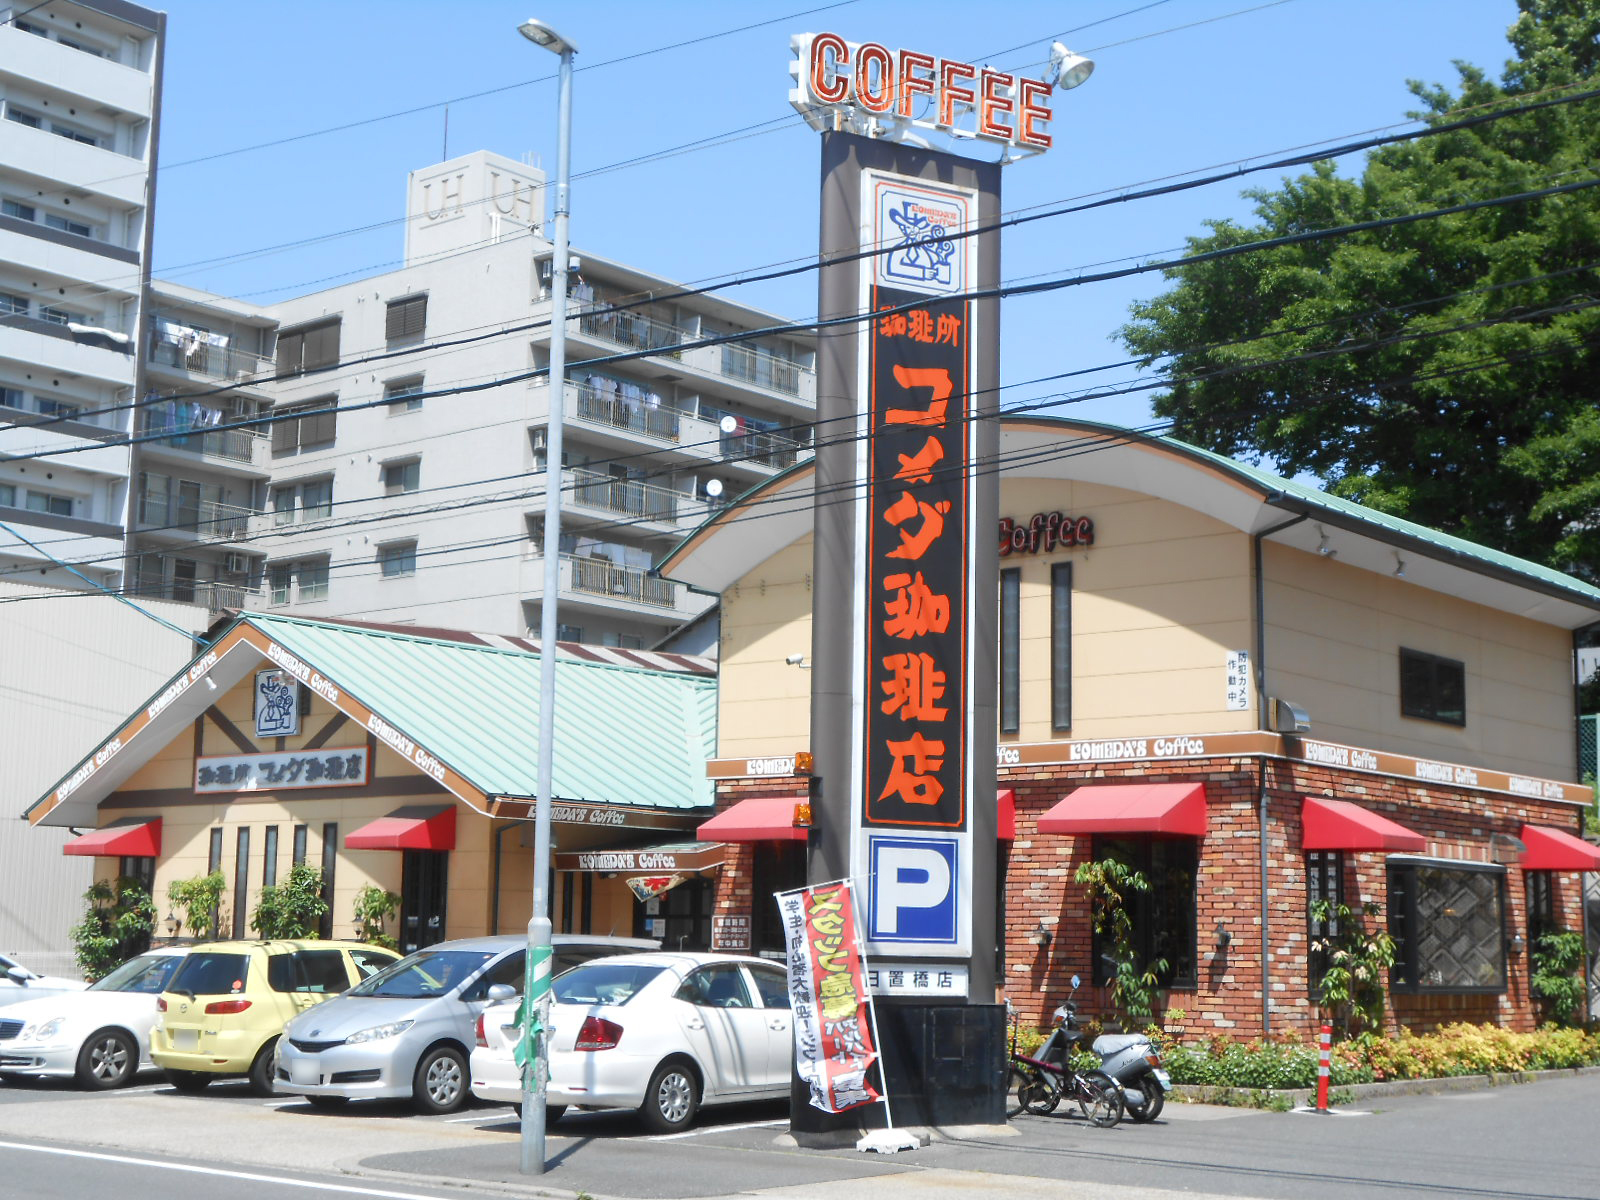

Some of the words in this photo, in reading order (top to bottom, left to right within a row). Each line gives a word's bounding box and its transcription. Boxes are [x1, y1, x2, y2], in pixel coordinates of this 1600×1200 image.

[810, 32, 1053, 148] COFFEE
[878, 364, 953, 806] コメダ珈琲店
[190, 651, 217, 680] Coffee
[311, 674, 339, 702] Coffee
[1227, 660, 1237, 702] 作動中
[1238, 652, 1248, 708] 防犯カメラ
[95, 738, 121, 766] Coffee
[1070, 740, 1147, 760] KOMEDA'S
[1153, 737, 1204, 756] Coffee
[1305, 743, 1349, 766] KOMEDA'S
[1351, 750, 1377, 770] Coffee
[415, 750, 446, 780] Coffee
[747, 759, 796, 775] KOMED
[1455, 767, 1478, 785] Coffee
[527, 805, 587, 822] KEDA'S
[589, 809, 625, 825] Coffee
[579, 854, 635, 869] KOMEDA'S
[639, 853, 676, 869] Coffee
[876, 847, 950, 934] P
[866, 970, 952, 988] 日置橋店
